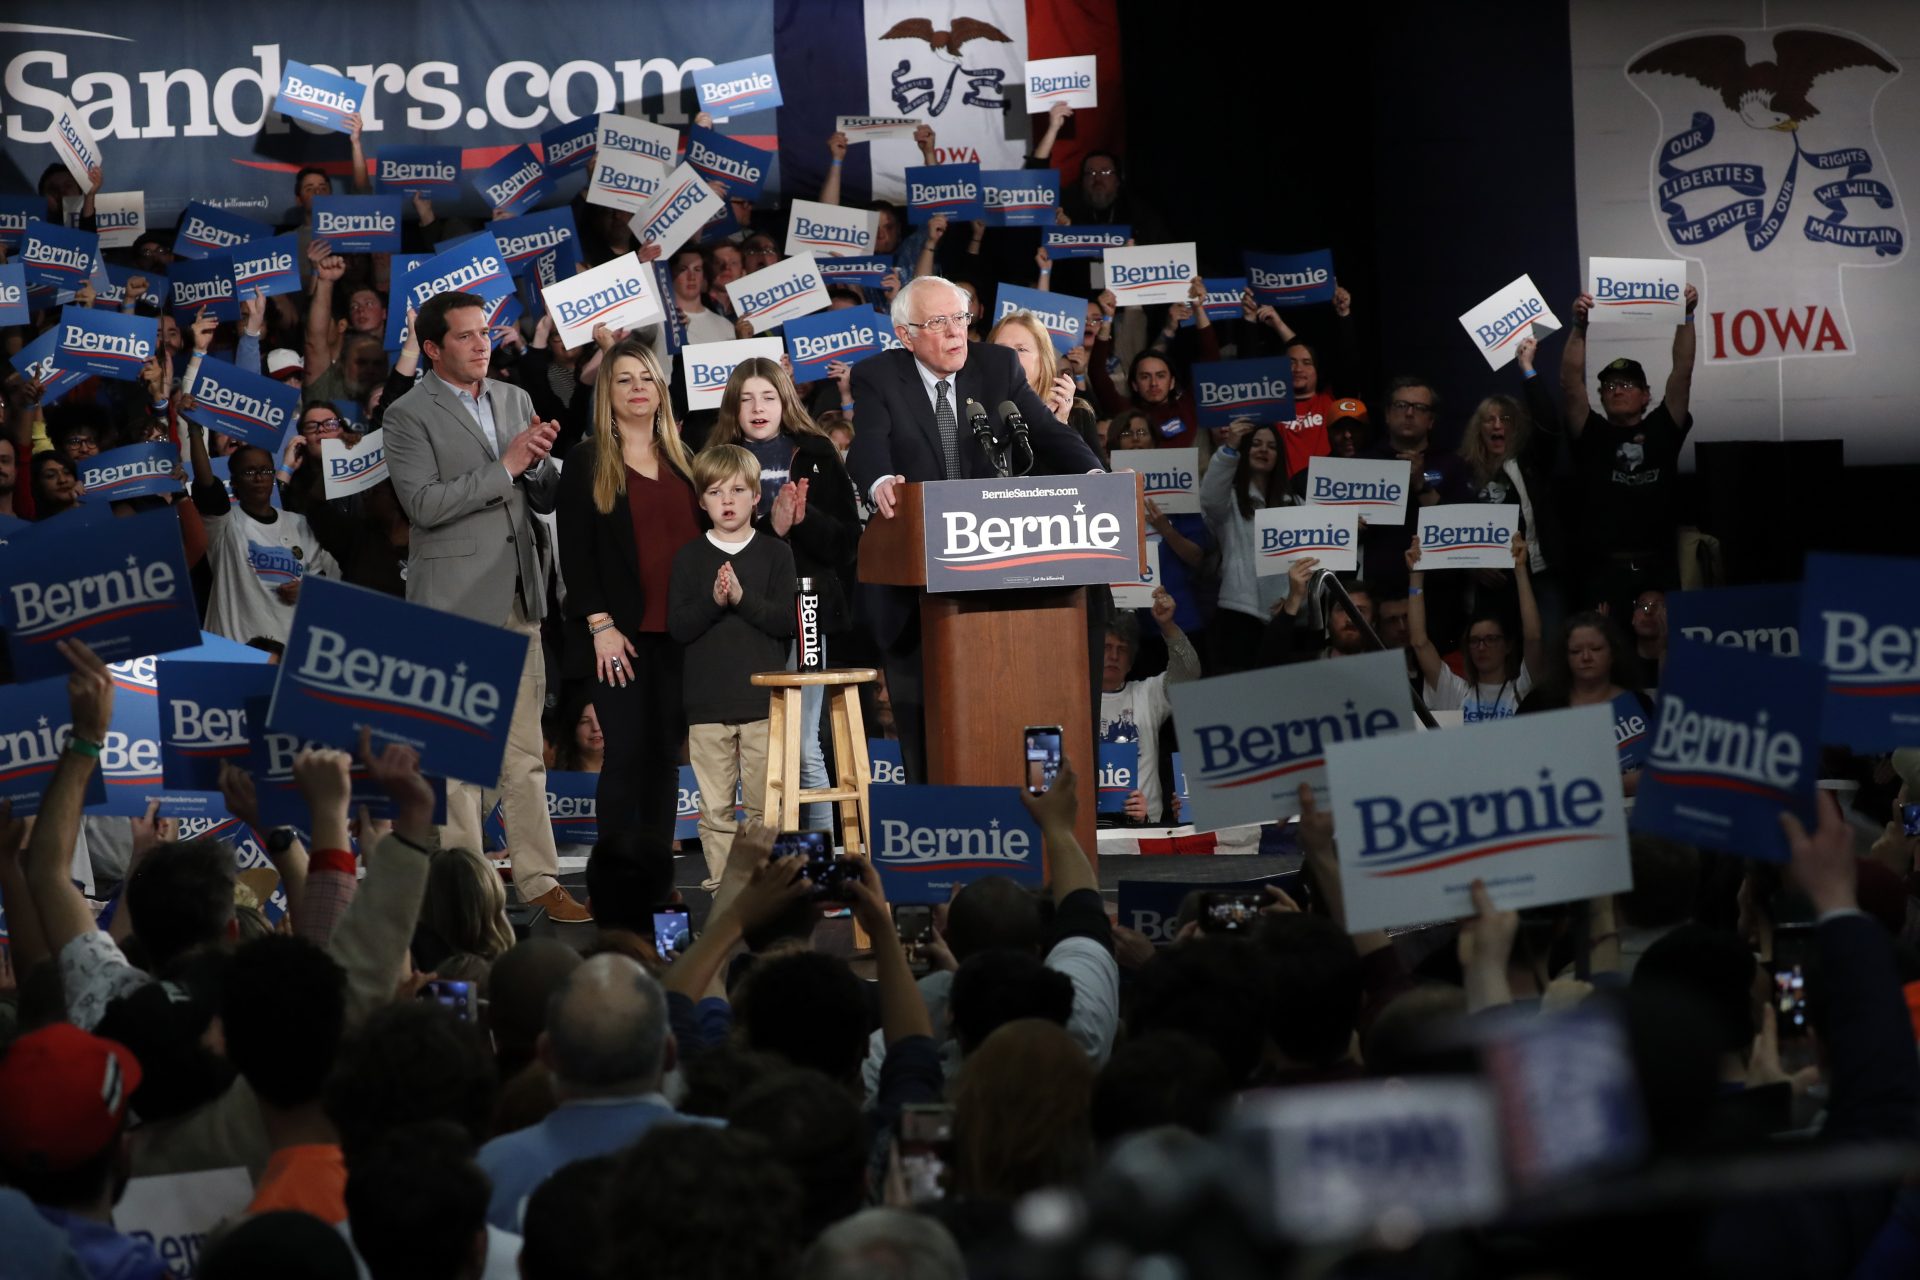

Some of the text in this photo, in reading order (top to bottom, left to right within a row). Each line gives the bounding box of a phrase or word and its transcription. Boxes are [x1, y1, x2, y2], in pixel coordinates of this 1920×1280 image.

[284, 77, 356, 114] Bernie
[701, 72, 773, 102] Bernie
[1030, 71, 1091, 93] Bernie
[58, 111, 97, 174] Bernie
[547, 126, 599, 163] Berni
[603, 129, 672, 162] Bernie
[931, 147, 981, 164] OWA
[1670, 131, 1704, 155] OUR
[382, 160, 456, 181] Bernie
[689, 141, 761, 183] Bernie
[1818, 150, 1867, 168] RIGHTS
[486, 161, 543, 206] Bernie
[598, 165, 660, 196] Berni
[911, 179, 977, 203] Bernie
[983, 184, 1055, 206] Bernie
[1663, 166, 1755, 199] LIBERTIES
[1818, 182, 1881, 202] WE WILL
[316, 210, 396, 232] Bernie
[643, 182, 708, 243] Bernie
[1676, 202, 1757, 242] WE PRIZE
[1753, 180, 1794, 247] AND OUR
[495, 226, 572, 257] Bernie
[794, 217, 870, 246] Bernie
[1047, 232, 1125, 246] Bernie
[1809, 220, 1898, 244] MAINTAIN
[24, 237, 90, 271] Bernie
[233, 251, 292, 279] ernie
[816, 261, 887, 273] Bernie
[413, 256, 500, 305] Bernie
[1111, 260, 1191, 285] Bernie
[1251, 266, 1328, 289] Bernie
[172, 275, 234, 303] Bernie
[556, 278, 642, 324] Bernie
[738, 273, 816, 314] Bernie
[1596, 278, 1680, 301] Bernie
[1475, 298, 1543, 347] Bernie
[1710, 304, 1849, 359] IOWA
[62, 324, 150, 359] Bernie
[793, 324, 875, 359] Bernie
[692, 363, 737, 386] Ber
[1199, 376, 1287, 404] Bernie
[196, 376, 285, 428] Bernie
[1339, 401, 1356, 412] C
[83, 456, 174, 487] Bernie
[1143, 466, 1193, 491] rnie
[981, 487, 1079, 500] BernieSanders.com
[1313, 476, 1402, 501] Bernie
[941, 499, 1121, 555] Bernie
[1262, 523, 1350, 550] Bernie
[1422, 520, 1510, 546] Bernie
[10, 554, 176, 630] Bernie
[802, 594, 821, 667] Bernie
[298, 625, 500, 727] Bernie
[170, 700, 248, 741] Ber
[1194, 699, 1399, 773] Bernie
[1650, 694, 1802, 790] Bernie
[1353, 766, 1604, 857] Bernie
[880, 817, 1030, 860] Bernie
